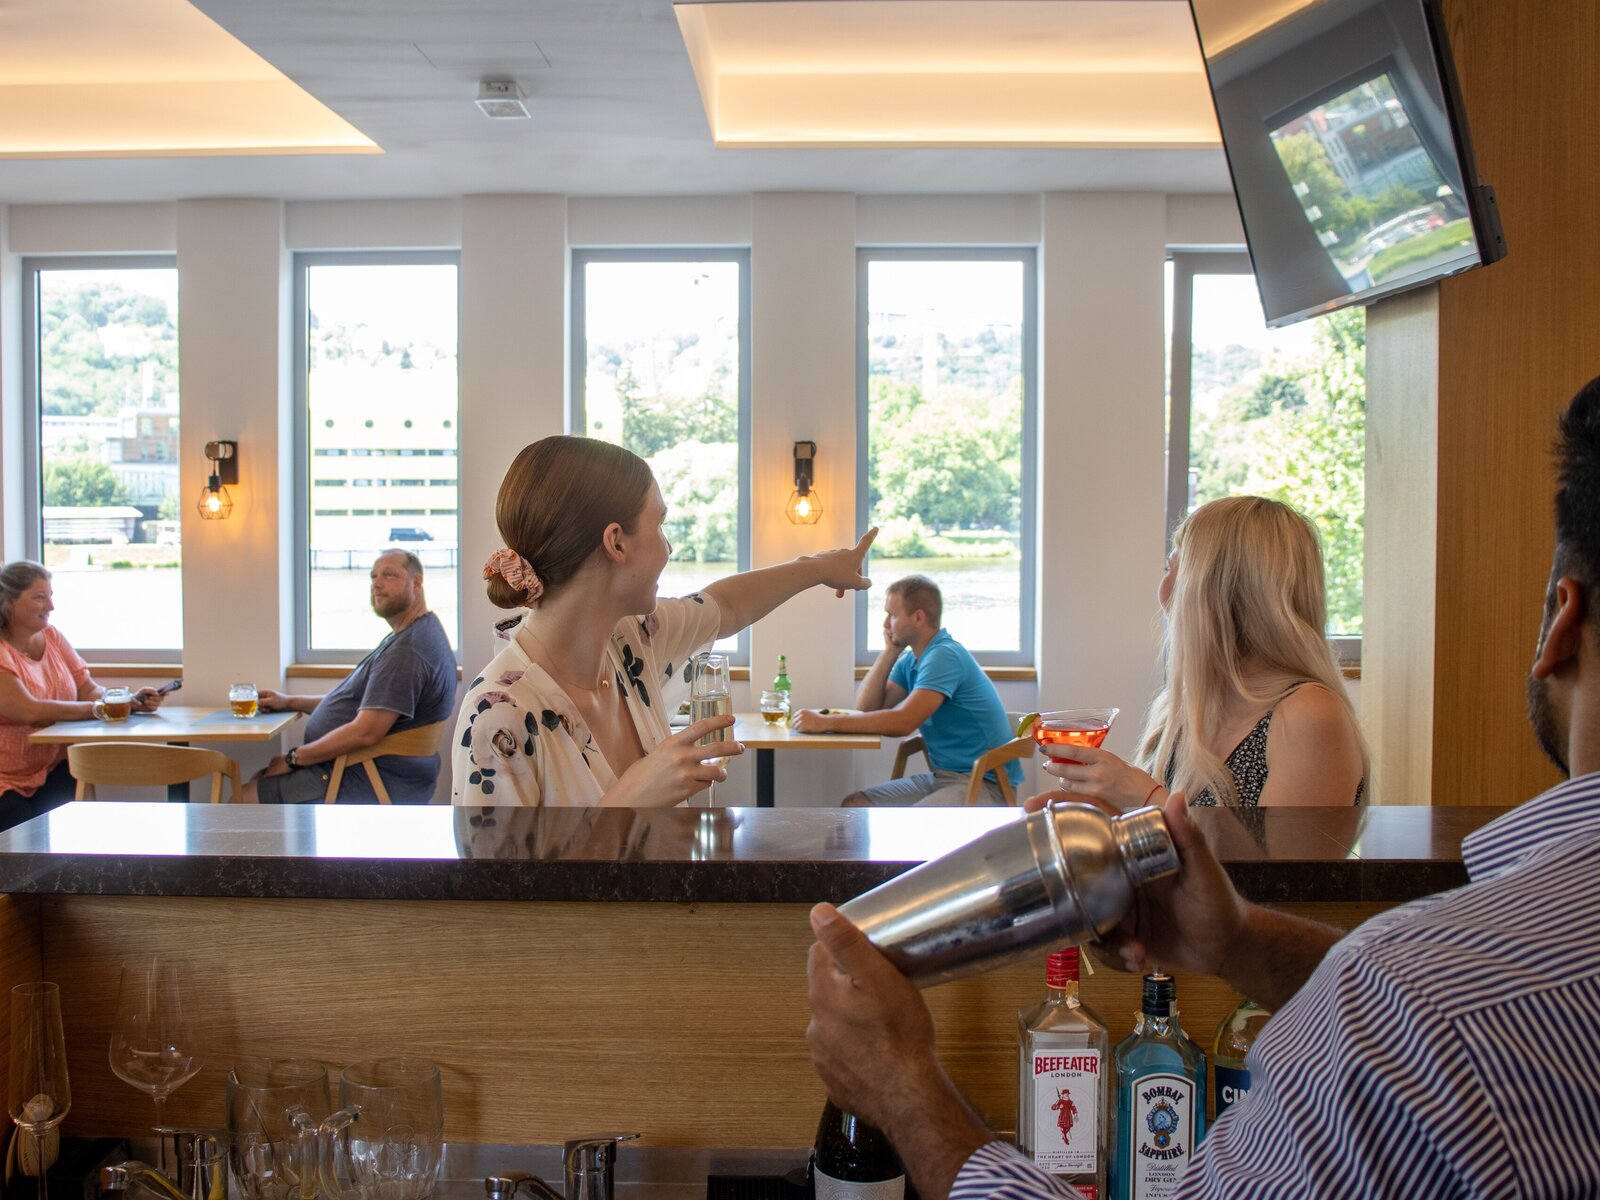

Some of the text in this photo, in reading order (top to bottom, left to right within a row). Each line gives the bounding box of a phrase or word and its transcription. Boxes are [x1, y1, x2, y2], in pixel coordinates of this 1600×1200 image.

[1034, 1056, 1098, 1075] BEEFEATER
[1142, 1086, 1185, 1105] BOMBAY
[1138, 1142, 1185, 1160] SAPPHIRE
